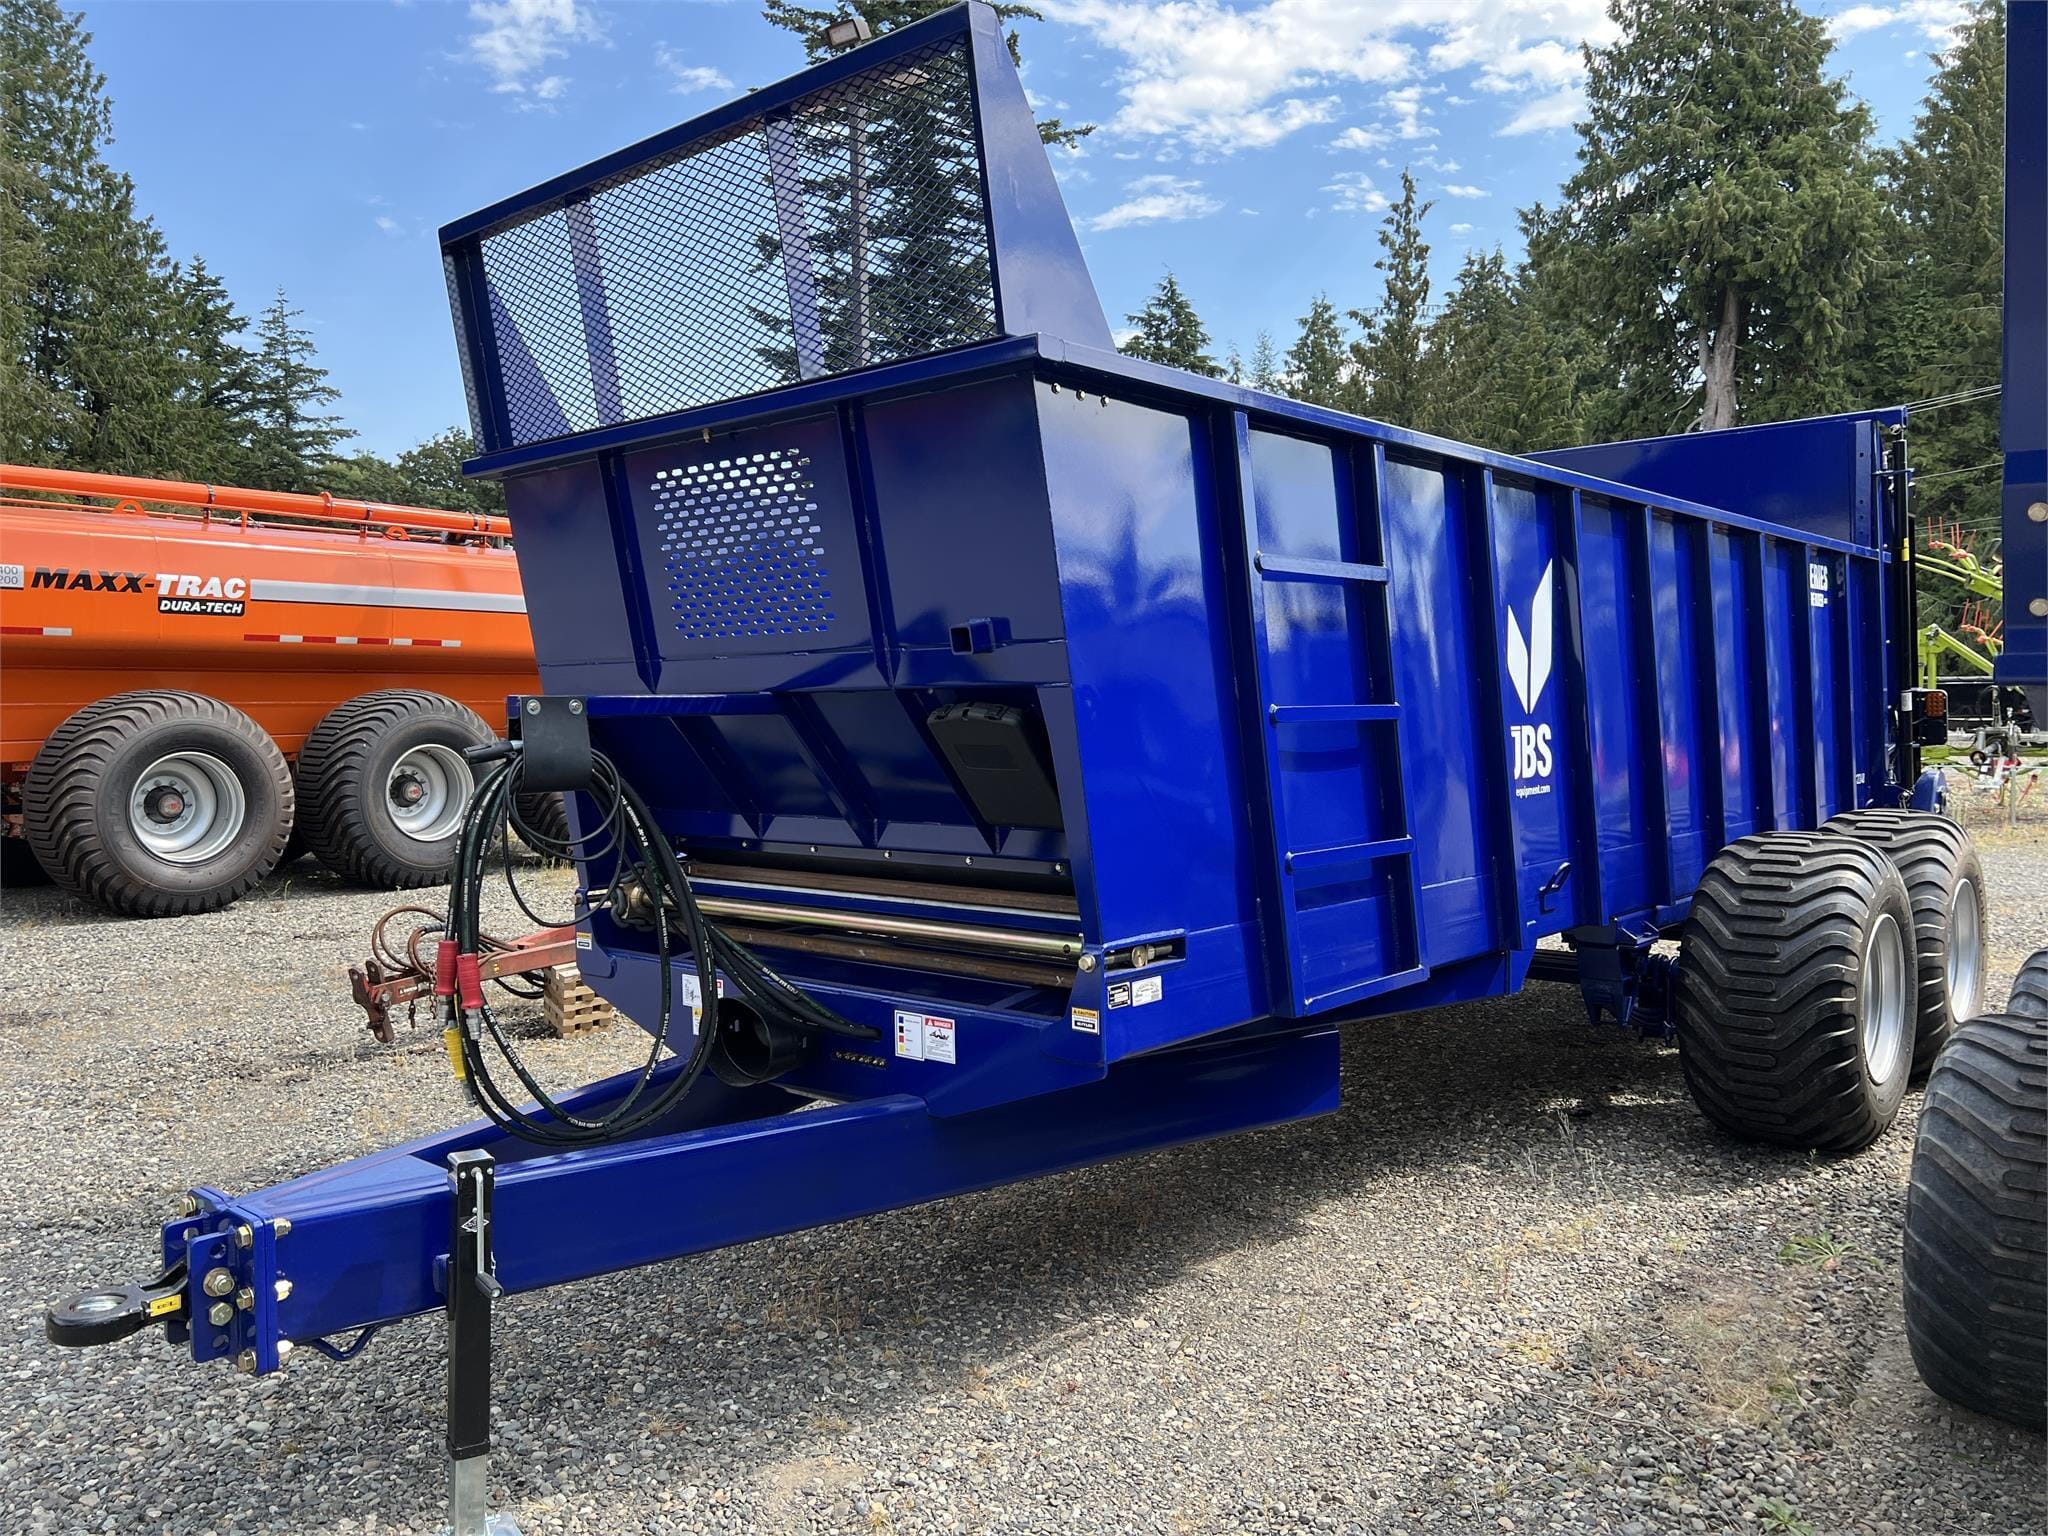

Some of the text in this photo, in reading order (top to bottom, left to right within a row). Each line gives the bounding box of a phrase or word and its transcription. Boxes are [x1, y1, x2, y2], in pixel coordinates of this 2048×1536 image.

[31, 567, 246, 599] MAXX-TRAC
[160, 600, 242, 614] DURA-TECH
[1511, 724, 1552, 779] JBS
[1516, 784, 1551, 798] equipment.com
